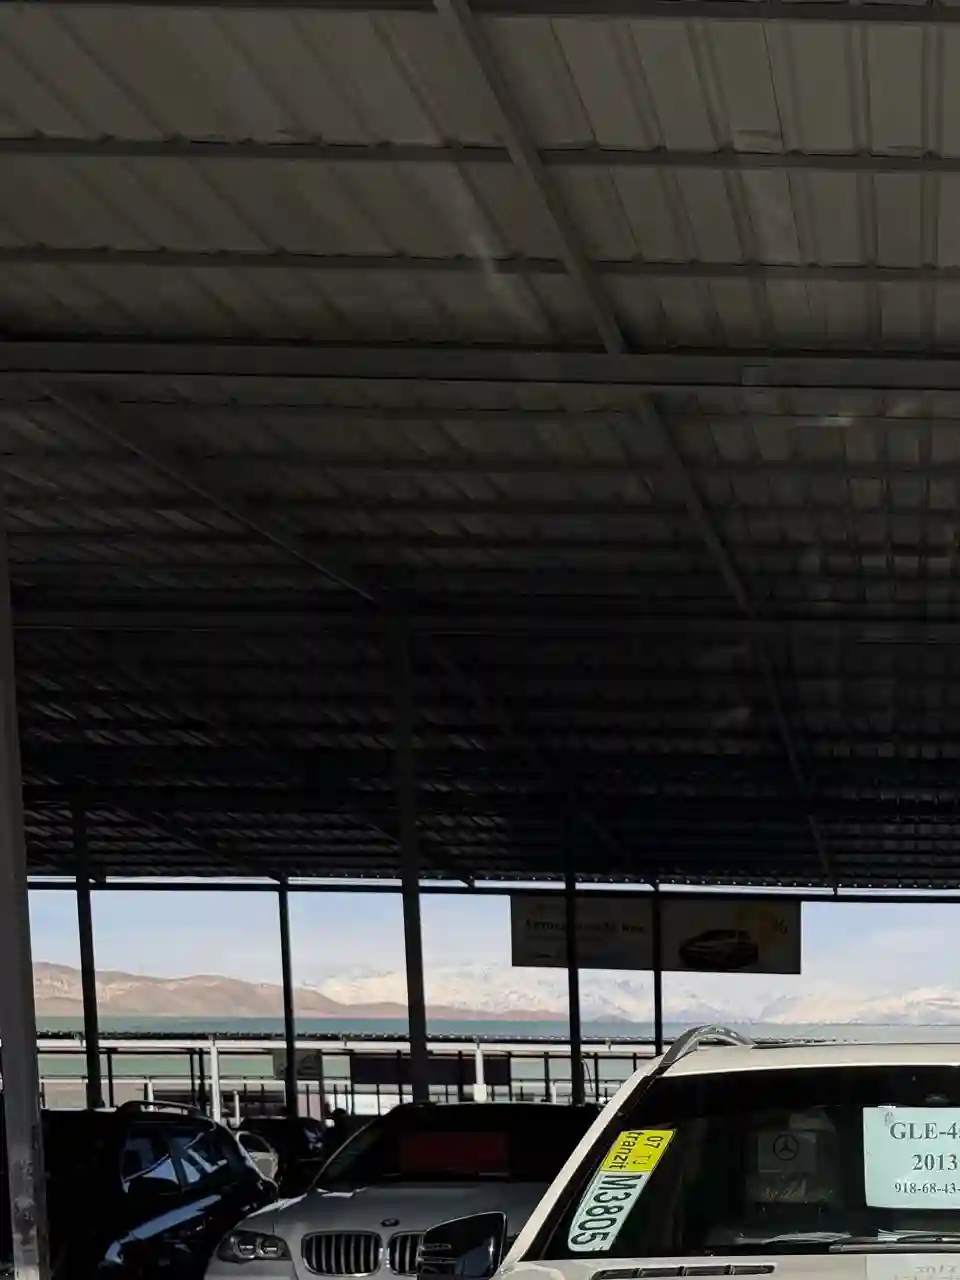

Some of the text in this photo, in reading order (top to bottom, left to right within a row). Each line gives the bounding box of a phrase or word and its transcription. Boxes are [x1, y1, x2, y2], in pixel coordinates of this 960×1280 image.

[609, 1131, 645, 1169] tranzit
[644, 1135, 664, 1149] 07
[912, 1153, 958, 1171] 2013
